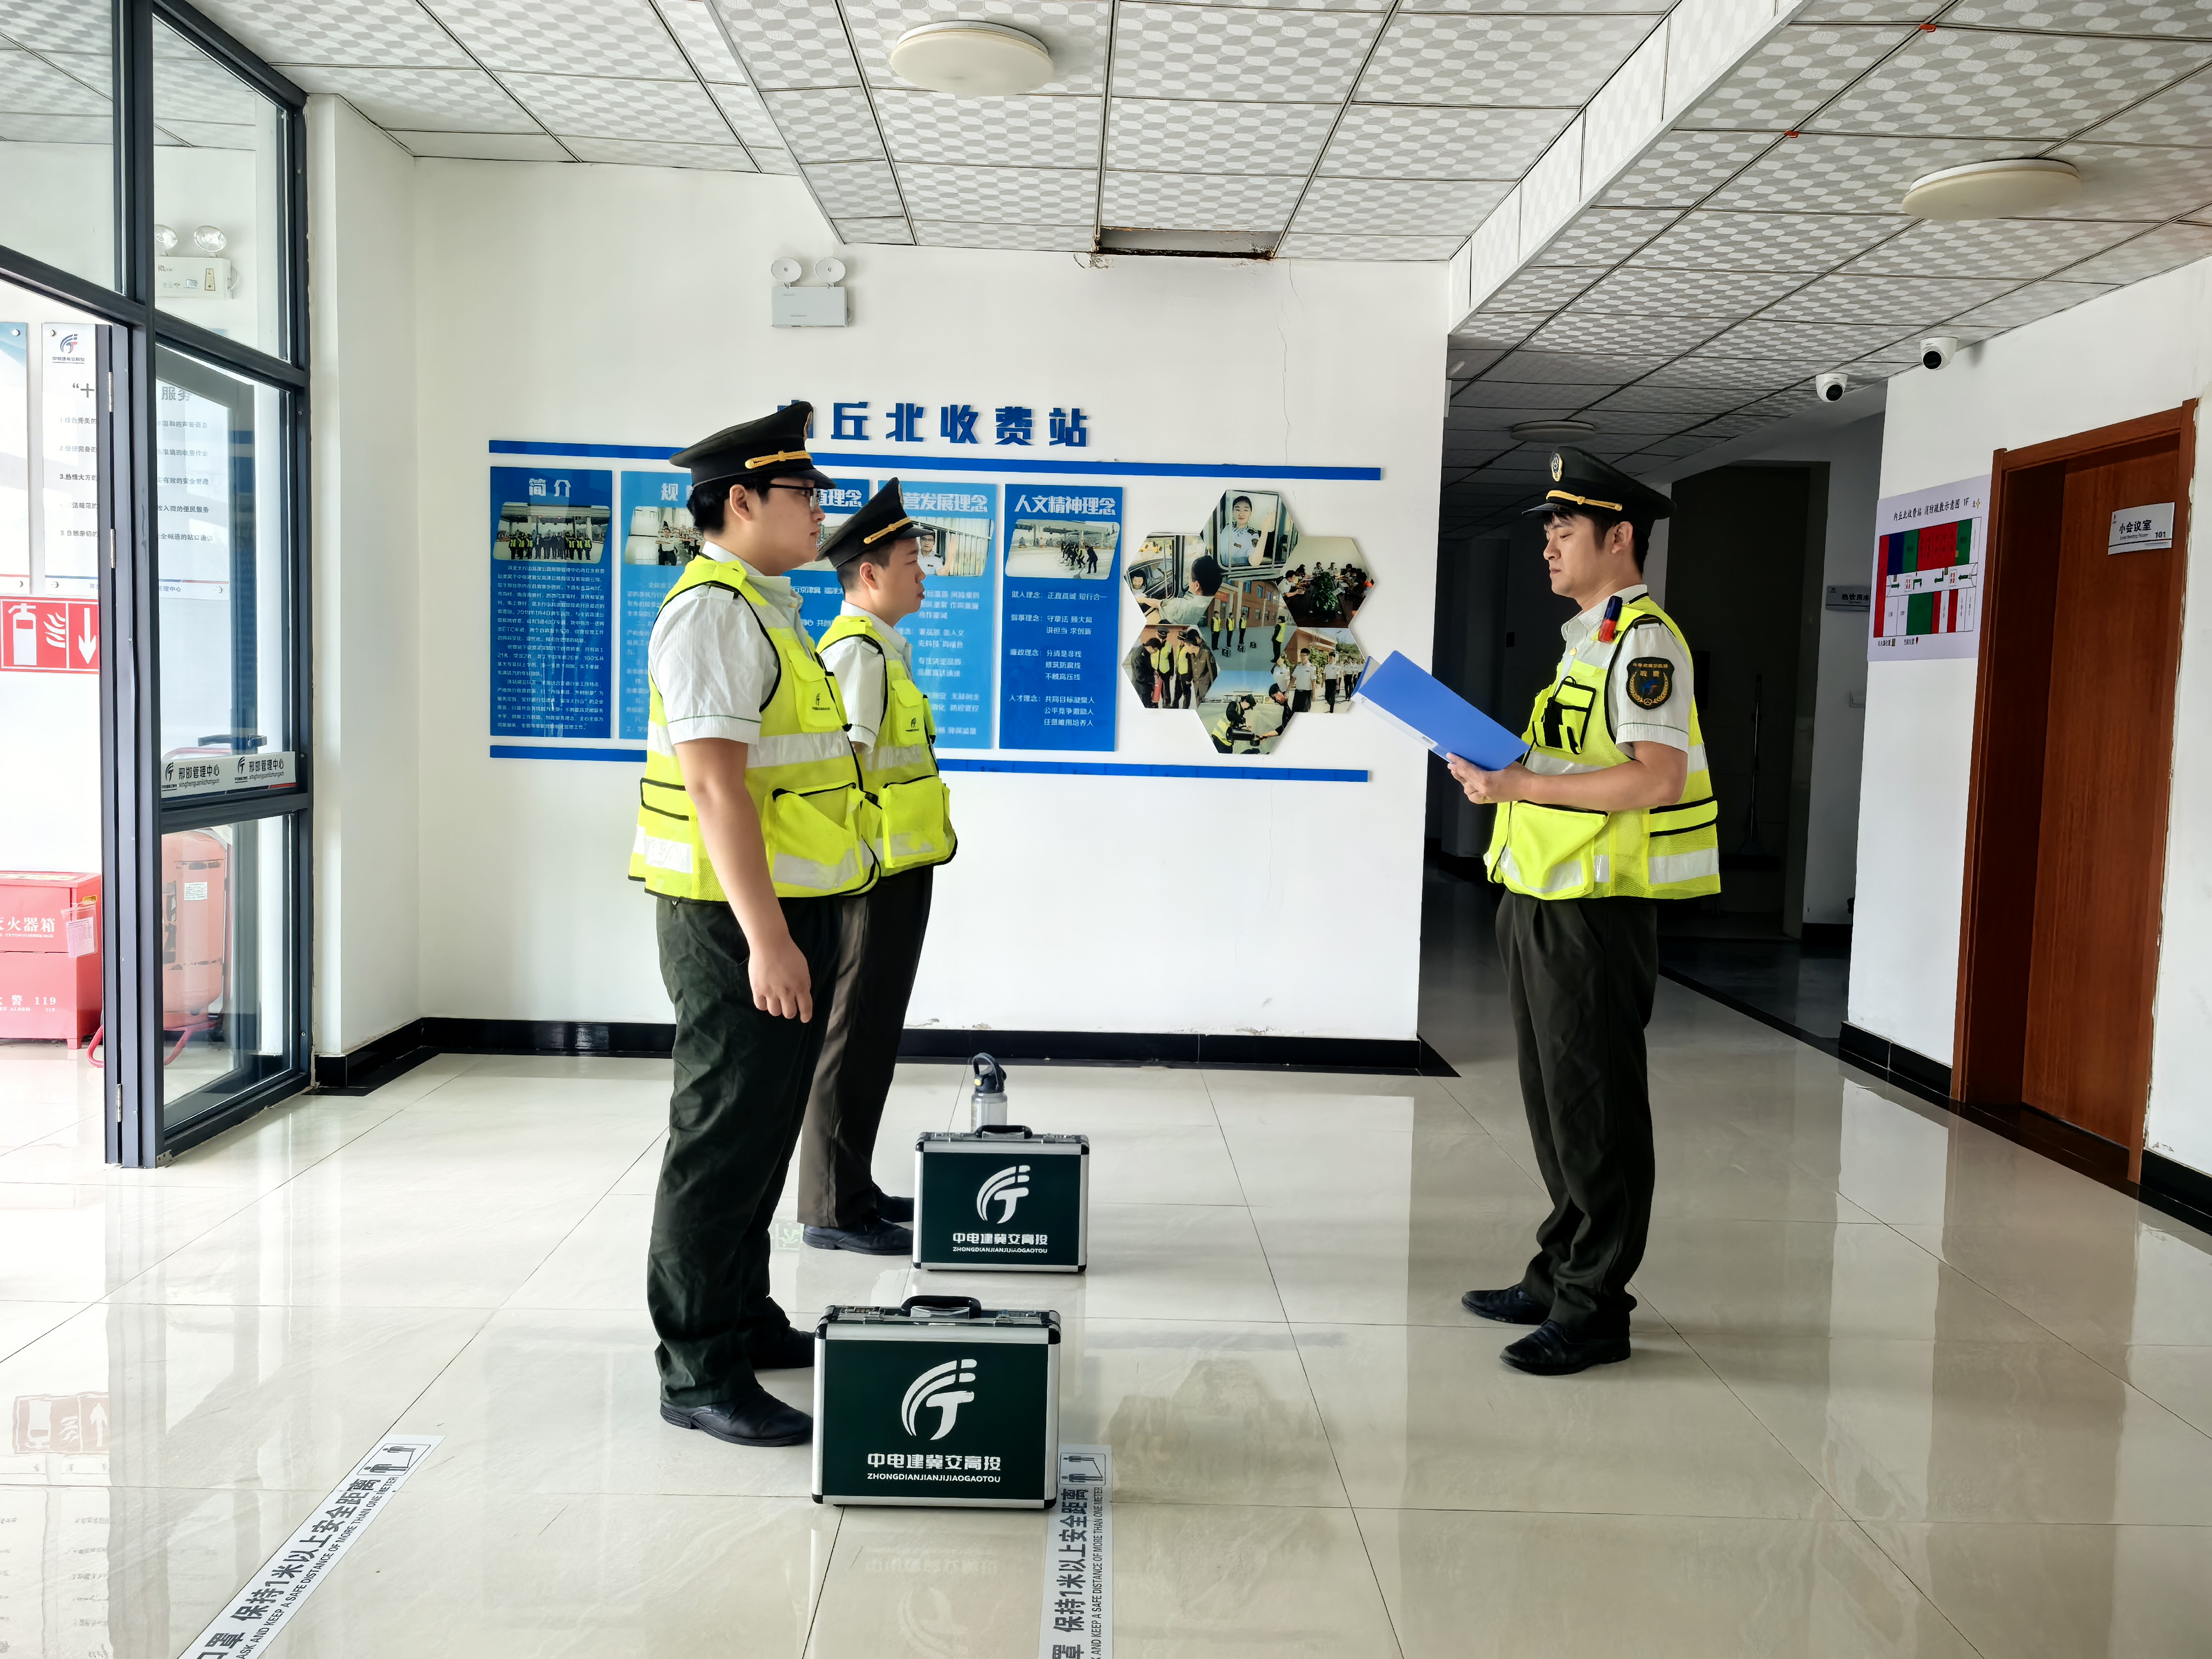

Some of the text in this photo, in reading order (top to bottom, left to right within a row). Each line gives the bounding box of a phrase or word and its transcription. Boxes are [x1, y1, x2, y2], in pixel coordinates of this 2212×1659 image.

[777, 400, 1087, 447] 丘北收费站
[529, 478, 571, 497] 简介
[661, 483, 693, 501] 规
[1014, 495, 1116, 515] 人文精神理念
[2119, 520, 2152, 534] 小会议室
[179, 764, 219, 780] 邢邯管理中心
[249, 758, 284, 773] 邢邯管理中心
[0, 916, 56, 932] 火器箱
[35, 996, 57, 1005] 119
[952, 1232, 1048, 1245] 中电建冀交高投
[867, 1453, 1001, 1472] 中电建冀交高投
[867, 1472, 1001, 1483] ZHONGDIANJIANJIJIAOGAOTOU
[1092, 1505, 1103, 1518] ONE
[1092, 1518, 1103, 1534] THAN
[230, 1478, 381, 1621] 保持1米以上安全距离
[1092, 1535, 1103, 1552] MORE
[1053, 1488, 1089, 1633] 保持1米以上安全距离
[1092, 1553, 1103, 1562] OF
[249, 1627, 270, 1643] AND
[262, 1609, 285, 1626] KEEP
[285, 1584, 308, 1601] SAFE
[300, 1553, 334, 1583] DISTANCE
[328, 1543, 341, 1552] OF
[335, 1525, 358, 1543] MORE
[350, 1508, 372, 1525] THAN
[366, 1495, 383, 1507] ONE
[1092, 1563, 1102, 1594] DISTANCE
[1091, 1595, 1102, 1613] SAFE
[1091, 1620, 1102, 1637] KEEP
[1090, 1639, 1102, 1656] AND
